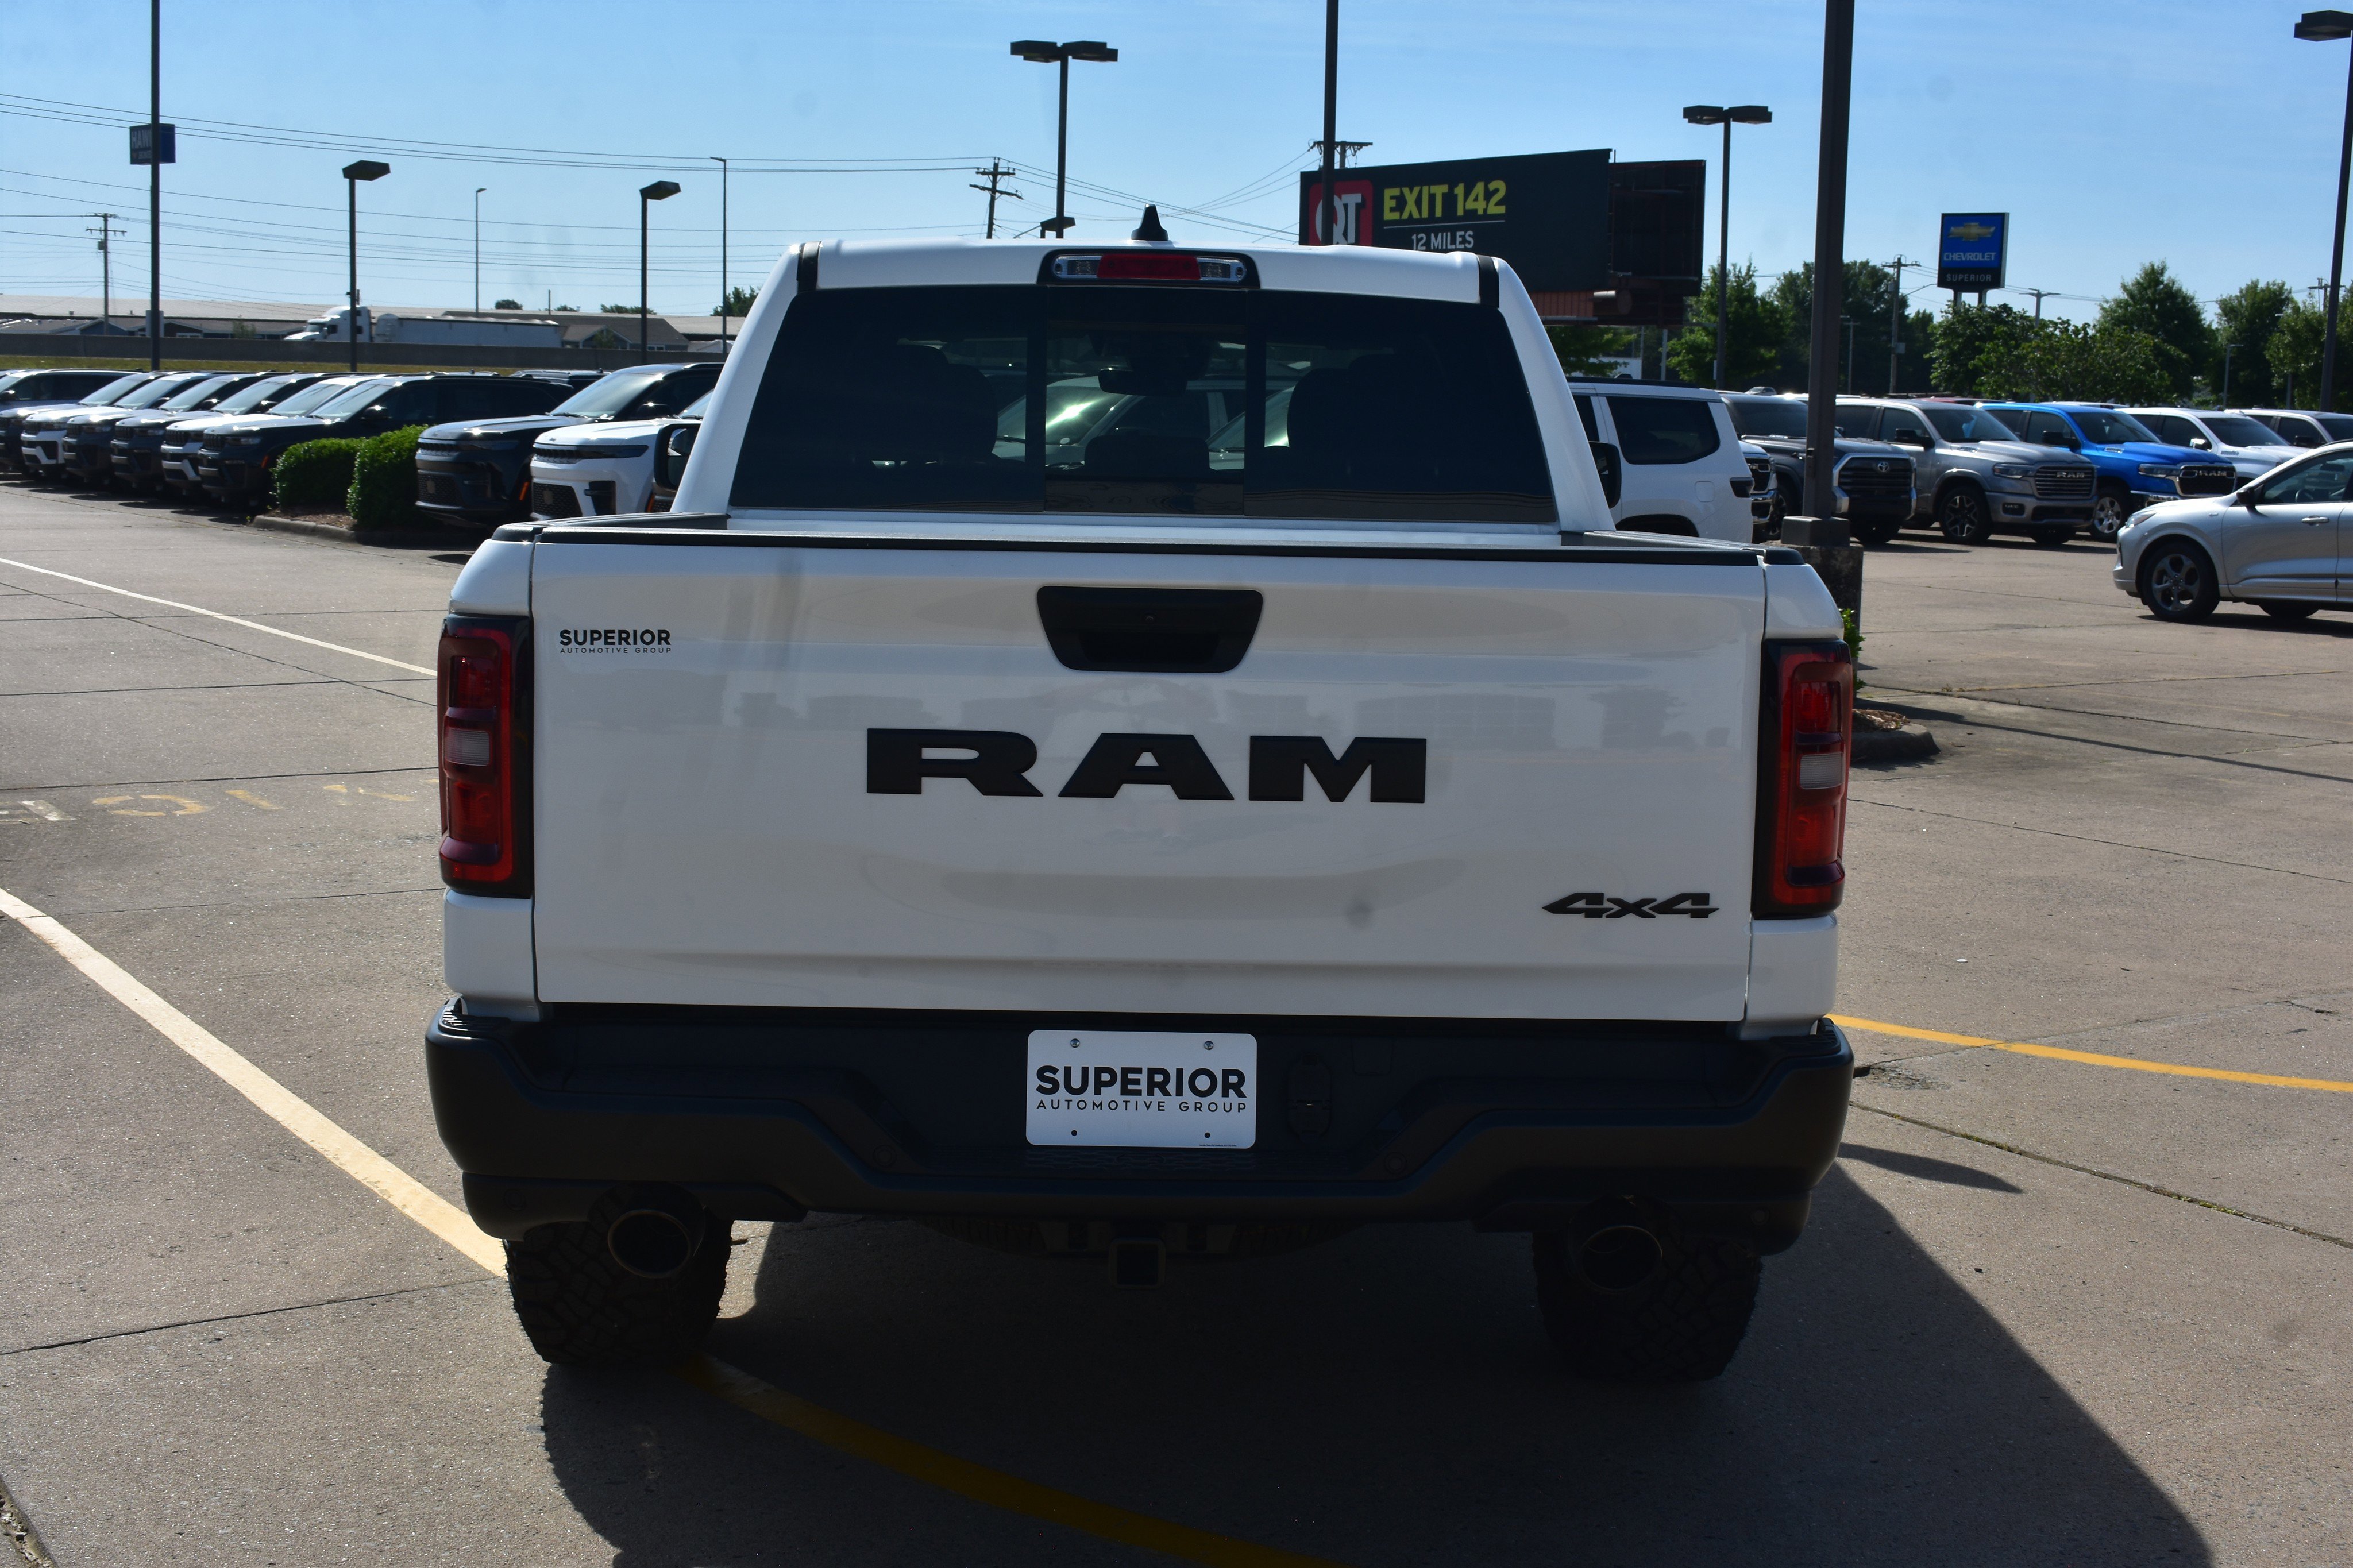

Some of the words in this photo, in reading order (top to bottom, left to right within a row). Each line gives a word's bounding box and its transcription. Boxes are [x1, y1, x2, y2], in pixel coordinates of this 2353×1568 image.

[1383, 184, 1448, 221] EXIT
[1454, 180, 1506, 216] 142
[1411, 233, 1426, 251] 12
[1430, 230, 1474, 249] MILES
[1943, 252, 1996, 261] CHEVROLET
[1946, 273, 1992, 282] SUPERIOR
[560, 629, 671, 646] SUPERIOR
[866, 728, 1427, 804] RAM
[1542, 892, 1720, 919] 4x4
[1035, 1065, 1247, 1098] SUPERIOR
[1036, 1099, 1166, 1112] AUTOMOTIVE
[1179, 1101, 1247, 1113] GROUP
